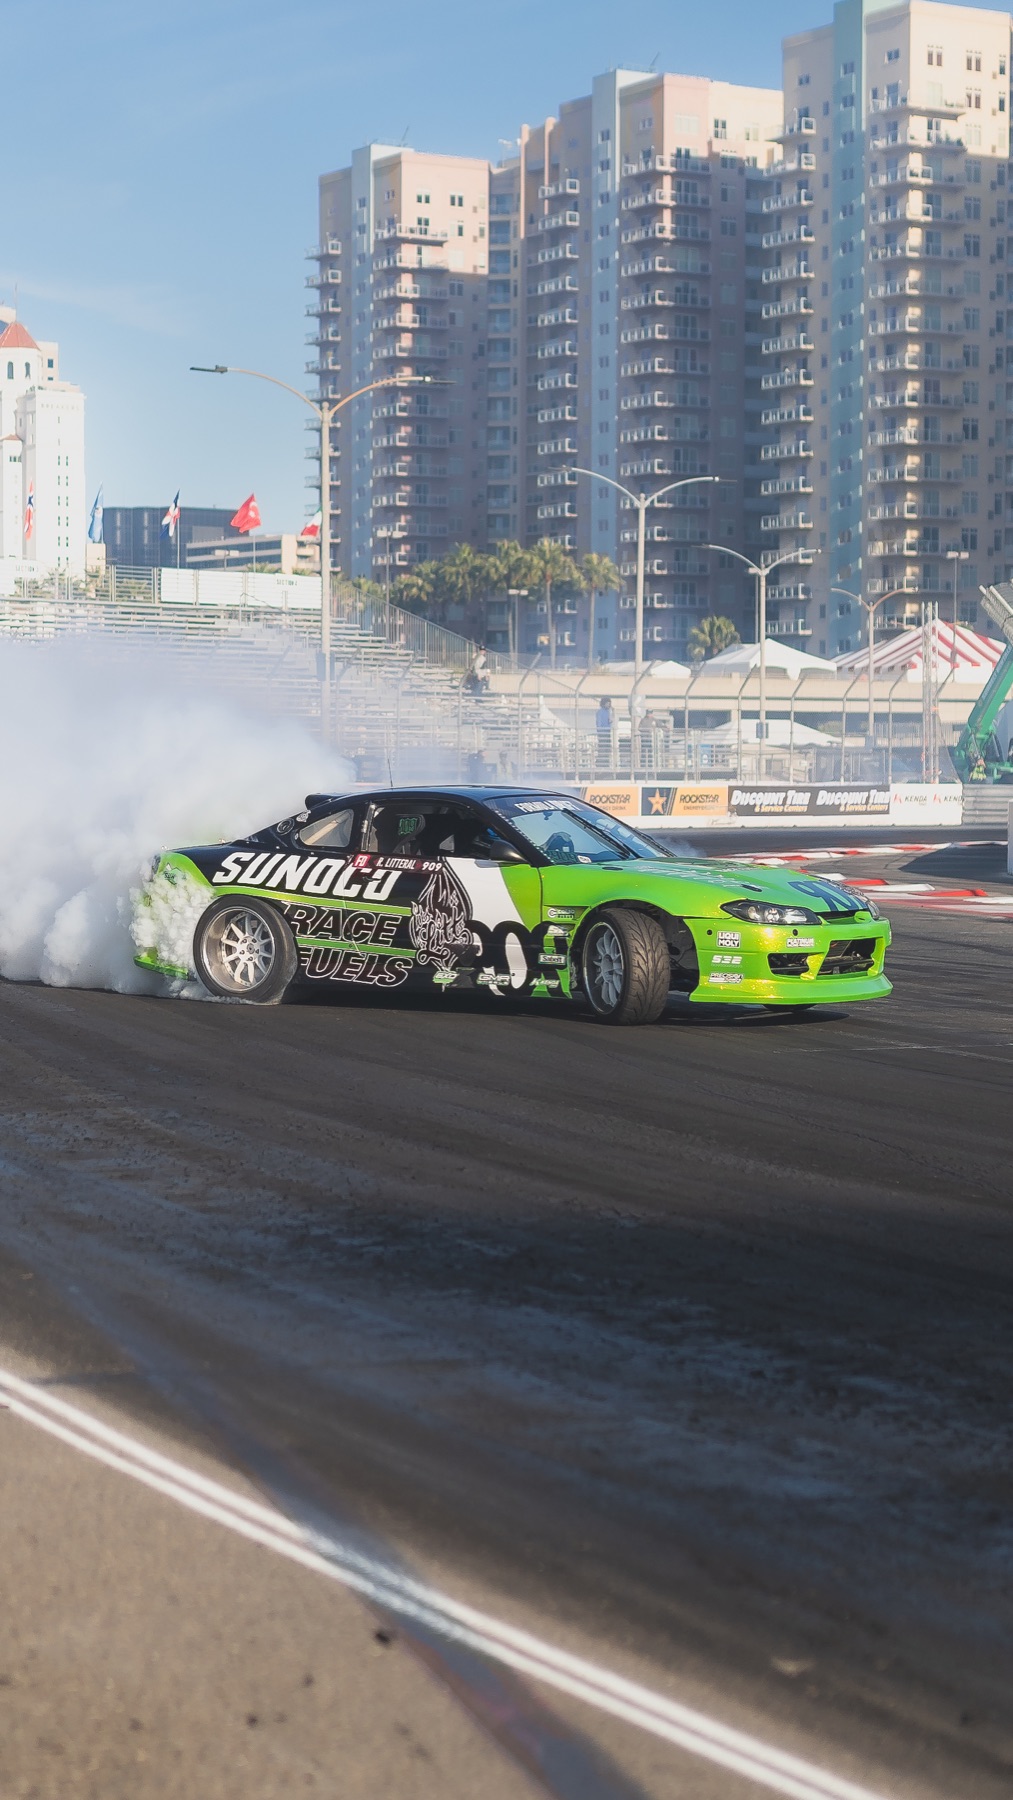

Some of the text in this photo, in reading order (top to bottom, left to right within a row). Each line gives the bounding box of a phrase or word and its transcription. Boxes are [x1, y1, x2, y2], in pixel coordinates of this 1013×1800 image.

[276, 578, 294, 586] SECTION
[589, 794, 631, 804] ROCKSTAR
[679, 794, 720, 803] ROCKSTAR
[785, 789, 811, 806] TIRE
[755, 804, 809, 813] & Service Centers
[840, 803, 889, 812] & Service Centers
[354, 855, 442, 872] FD R. LITTERAL 909
[212, 851, 402, 901] SUNOCO
[281, 900, 402, 947] RACE
[718, 932, 740, 940] LIQUI
[718, 939, 740, 947] MOLY
